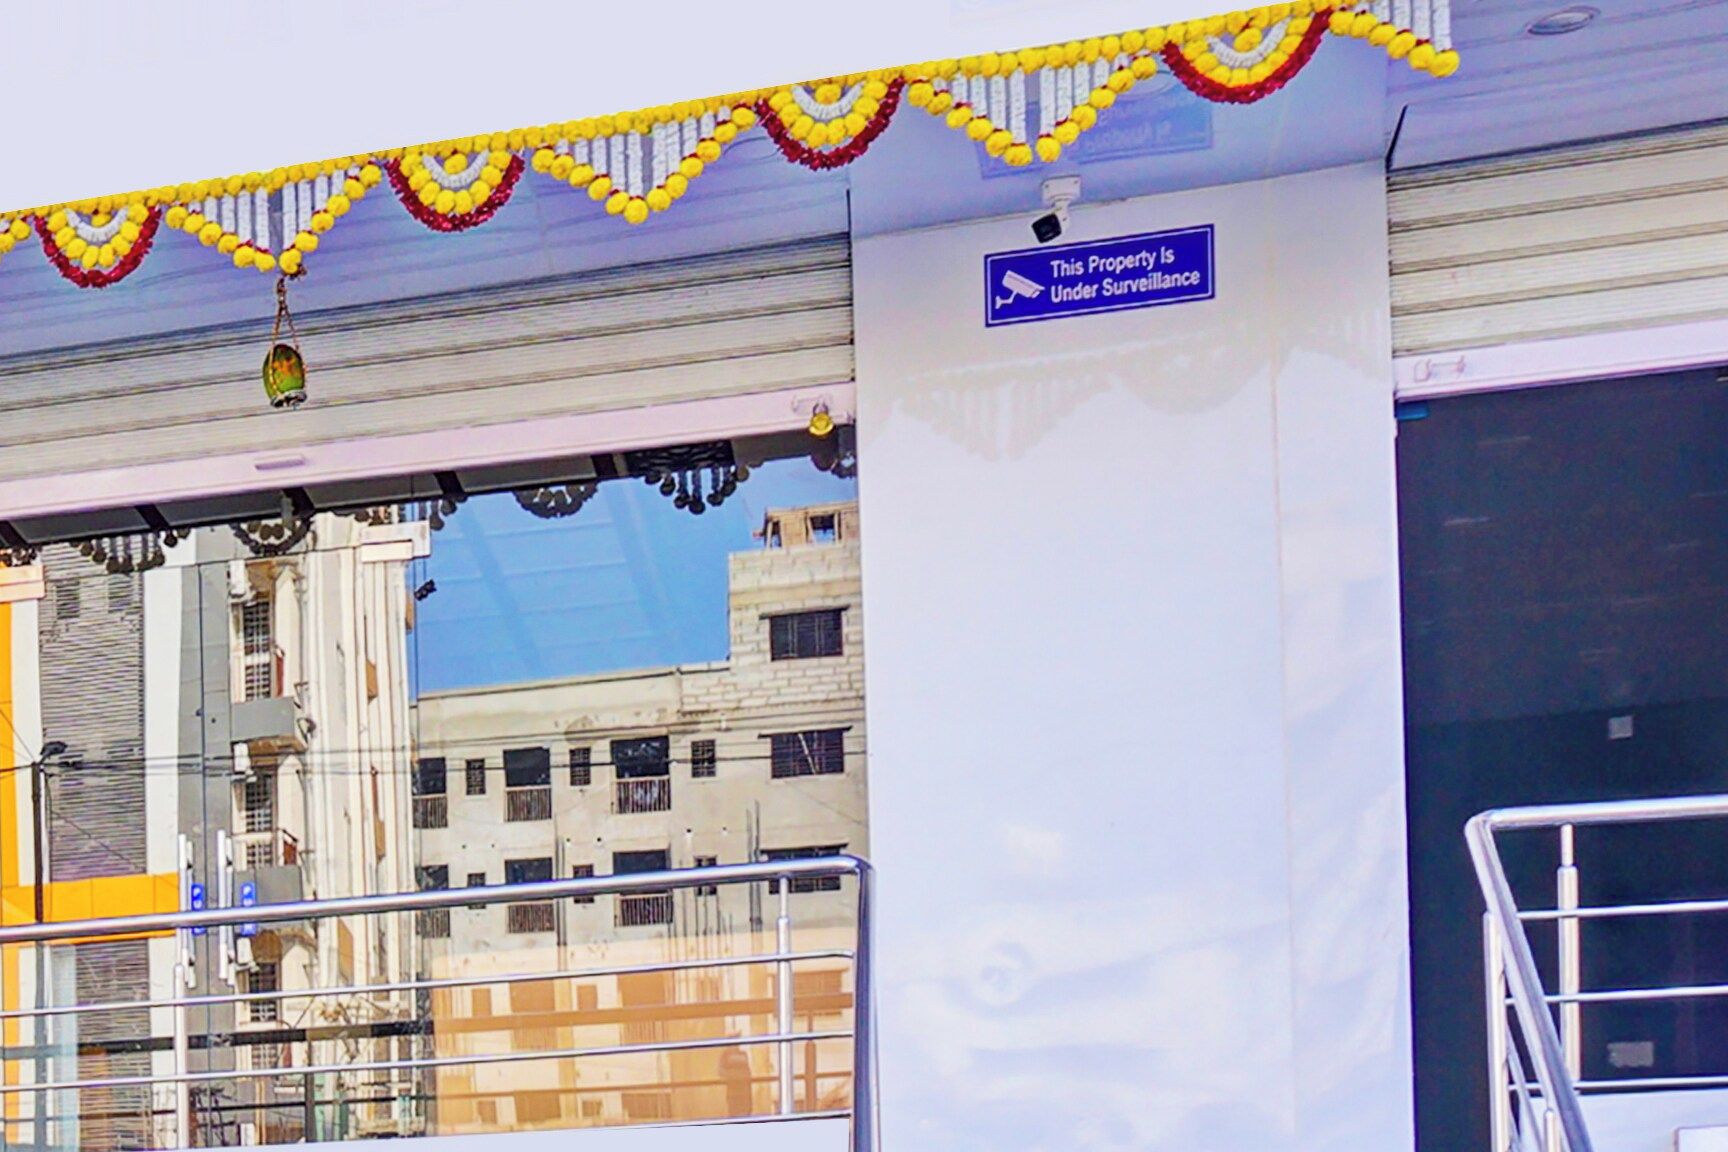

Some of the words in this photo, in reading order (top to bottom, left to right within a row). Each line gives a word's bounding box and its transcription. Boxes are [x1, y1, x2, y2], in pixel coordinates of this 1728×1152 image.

[1050, 258, 1084, 278] This
[1088, 249, 1157, 275] Property
[1160, 246, 1175, 264] Is
[1050, 282, 1100, 303] Under
[1102, 270, 1201, 296] Surveillance
